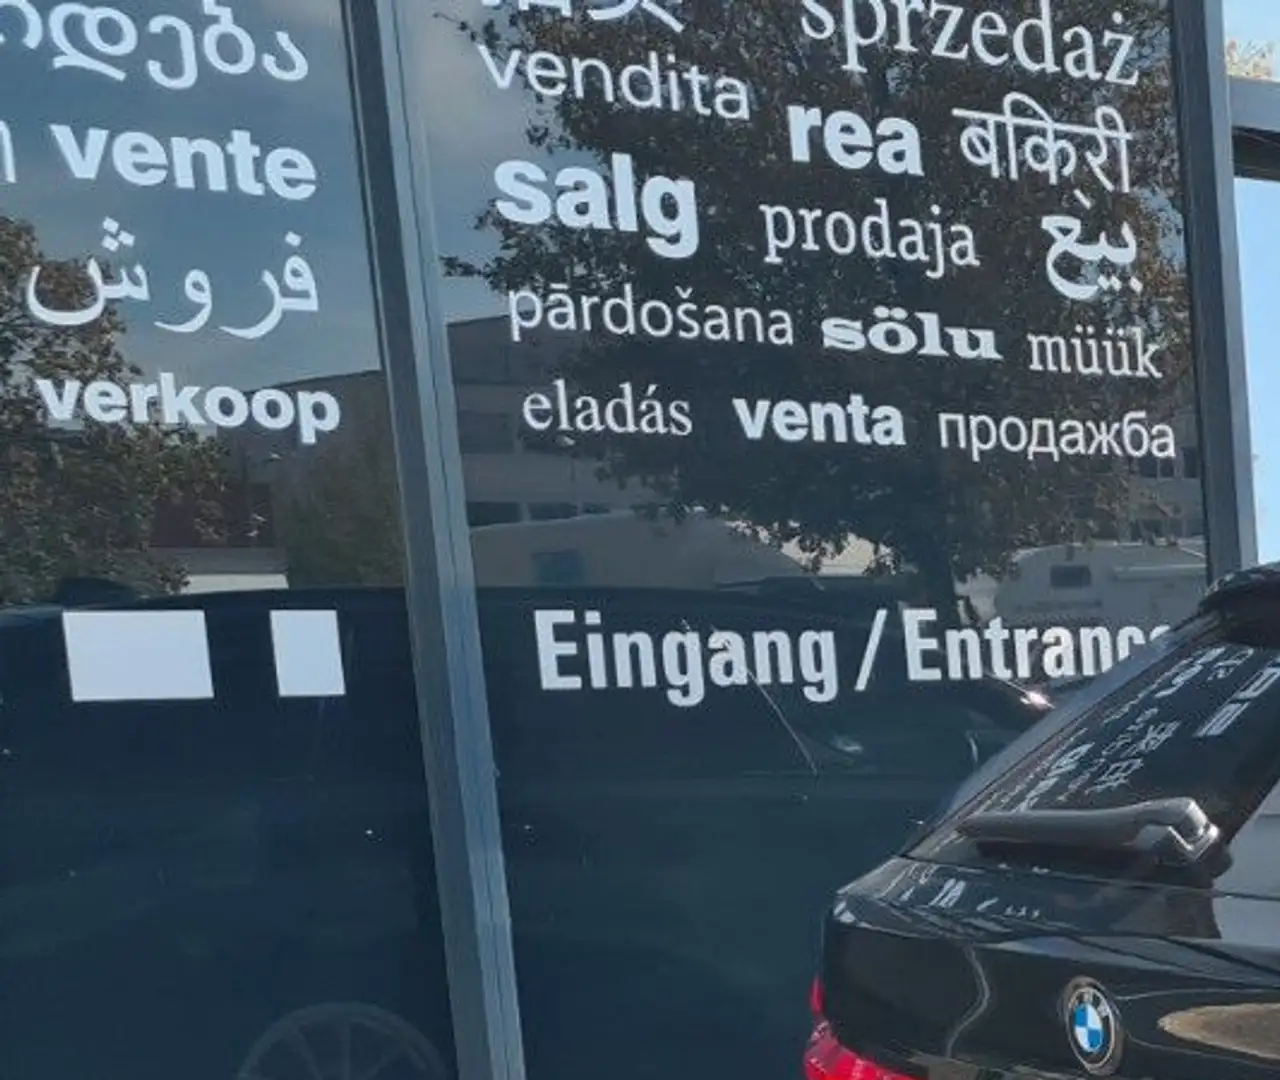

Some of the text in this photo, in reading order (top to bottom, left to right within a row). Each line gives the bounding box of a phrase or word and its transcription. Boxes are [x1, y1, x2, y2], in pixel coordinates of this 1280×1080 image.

[800, 0, 1140, 86] sprzedaż
[477, 44, 750, 121] vendita
[50, 124, 317, 201] vente
[786, 105, 925, 177] rea
[493, 152, 699, 259] salg
[758, 197, 981, 279] prodaja
[1041, 215, 1144, 301] بيع
[508, 283, 794, 345] pārdošana
[820, 305, 1004, 360] sölu
[1027, 324, 1163, 379] müük
[33, 370, 341, 445] verkoop
[522, 378, 693, 436] eladás
[731, 394, 907, 446] venta
[938, 410, 1177, 462] продажба
[534, 609, 838, 707] Eingang
